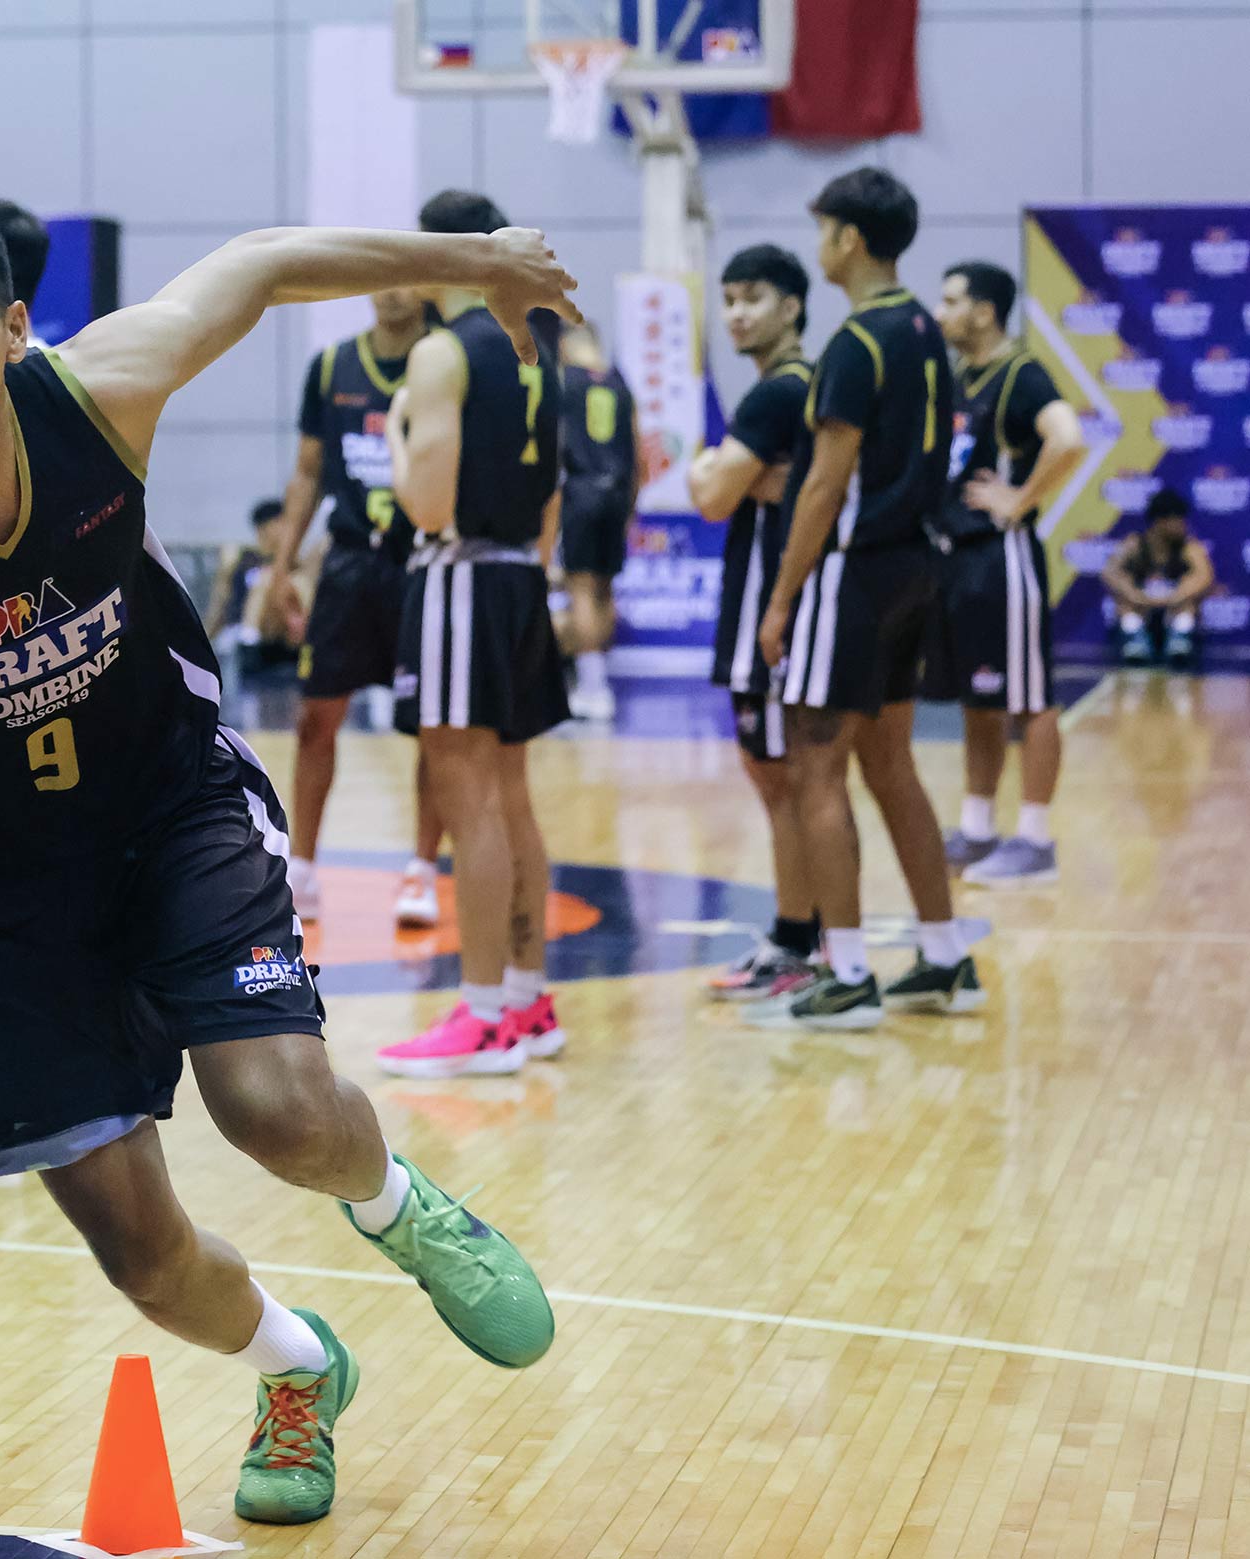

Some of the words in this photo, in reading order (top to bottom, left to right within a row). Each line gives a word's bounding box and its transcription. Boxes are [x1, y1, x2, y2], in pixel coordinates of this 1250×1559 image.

[6, 699, 68, 729] SEASON
[70, 688, 90, 705] 49
[26, 717, 80, 791] 9
[251, 946, 288, 963] PBA
